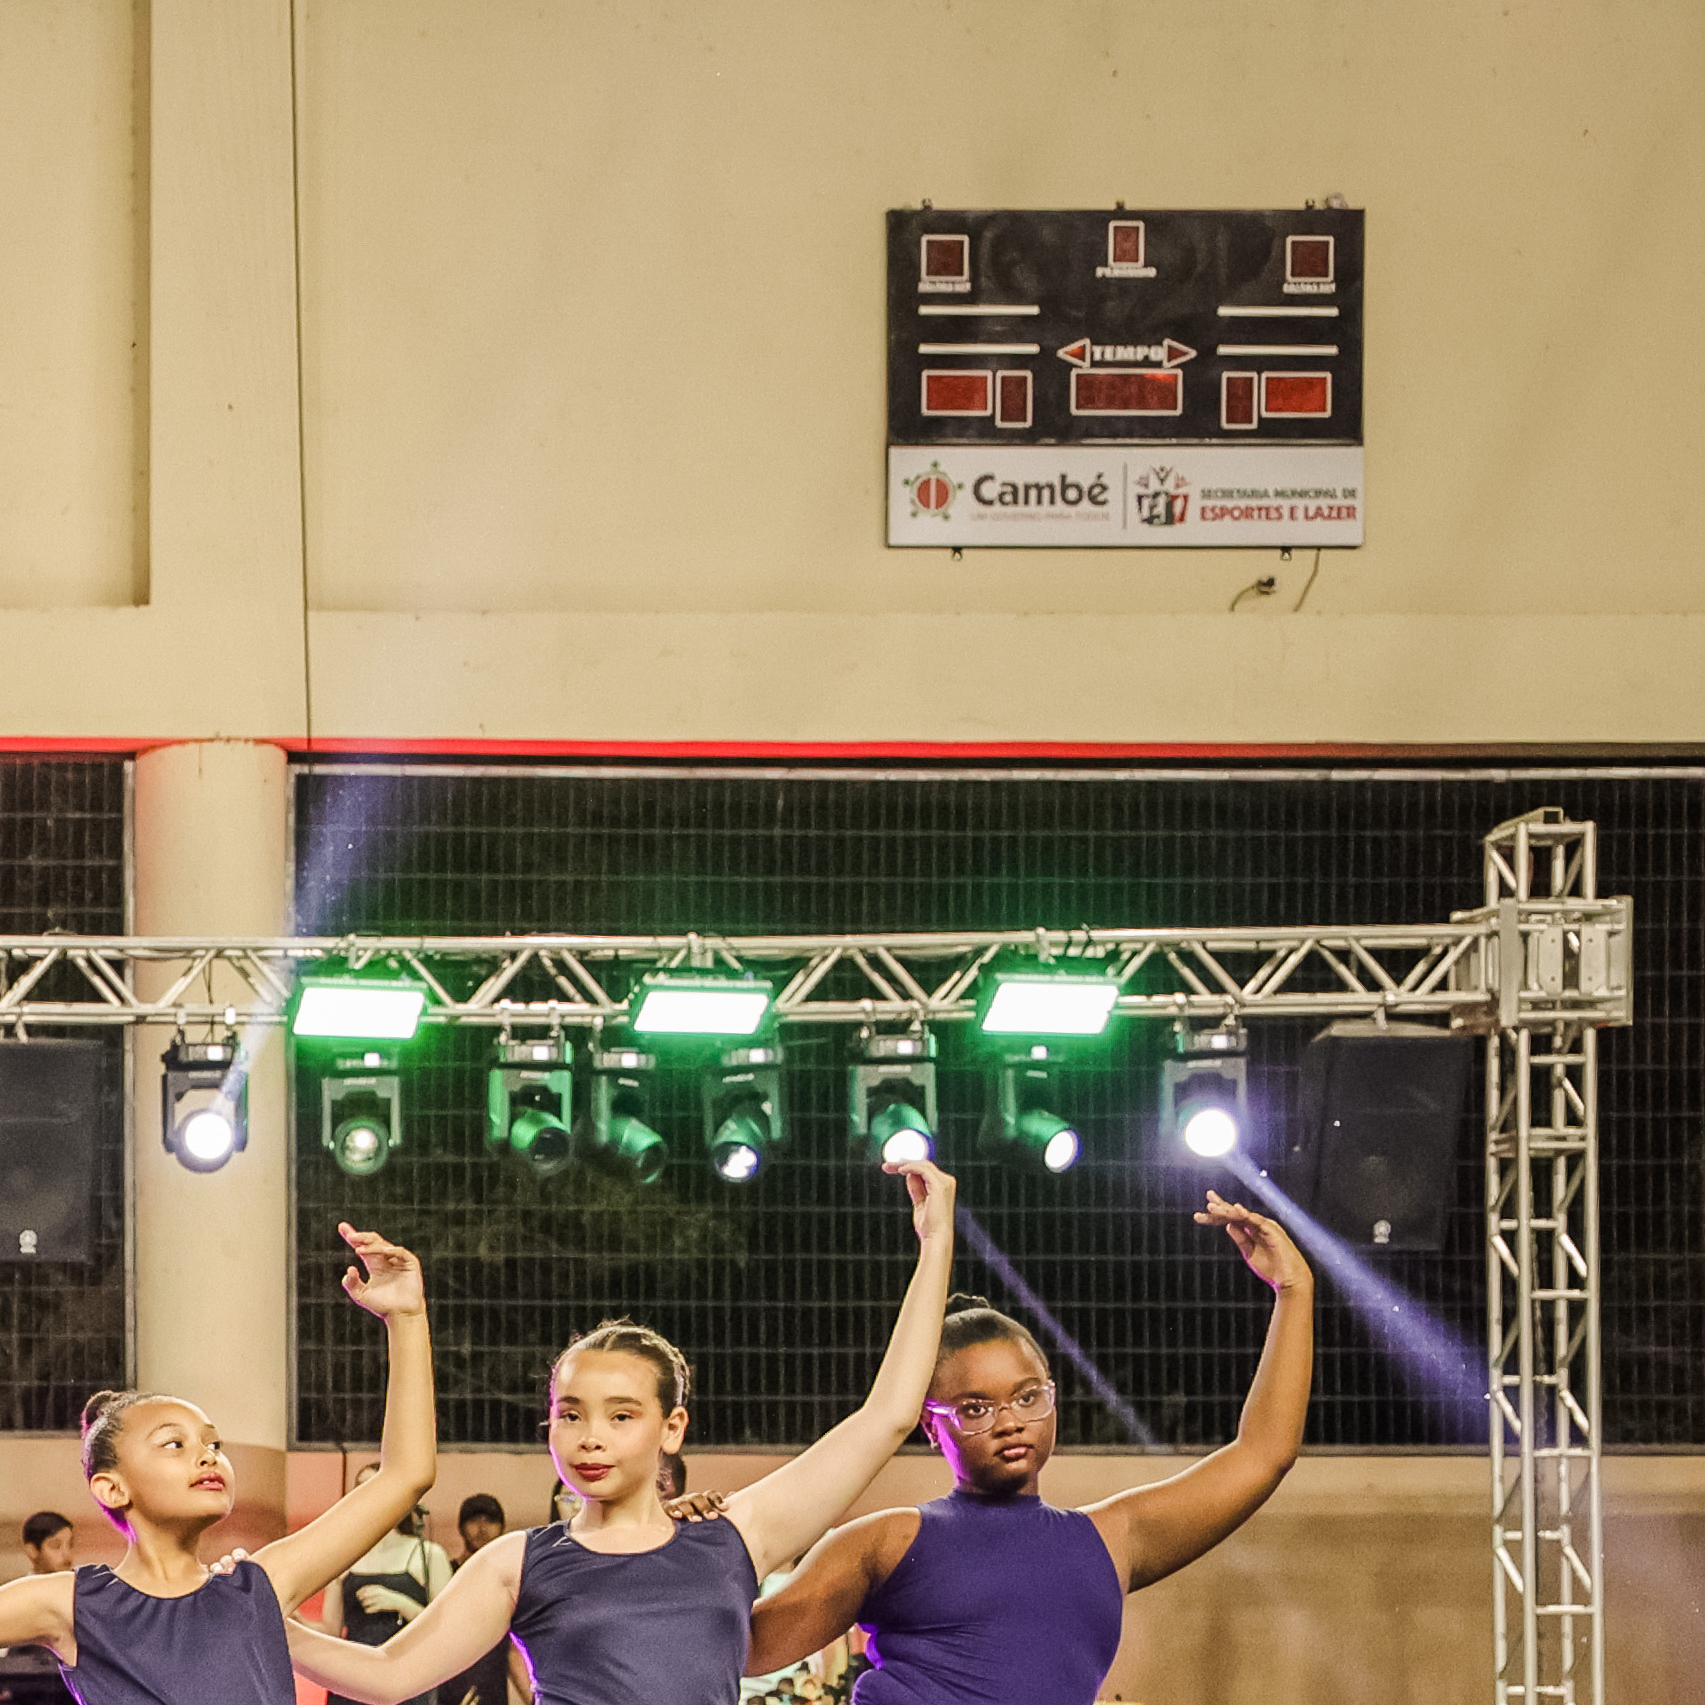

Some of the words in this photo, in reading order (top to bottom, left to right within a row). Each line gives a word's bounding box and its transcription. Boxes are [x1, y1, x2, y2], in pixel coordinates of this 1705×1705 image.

[1092, 344, 1164, 362] TEMPO
[972, 472, 1110, 507] Cambé
[1200, 505, 1283, 521] ESPORTES
[1290, 505, 1299, 521] E
[1304, 505, 1357, 521] LAZER
